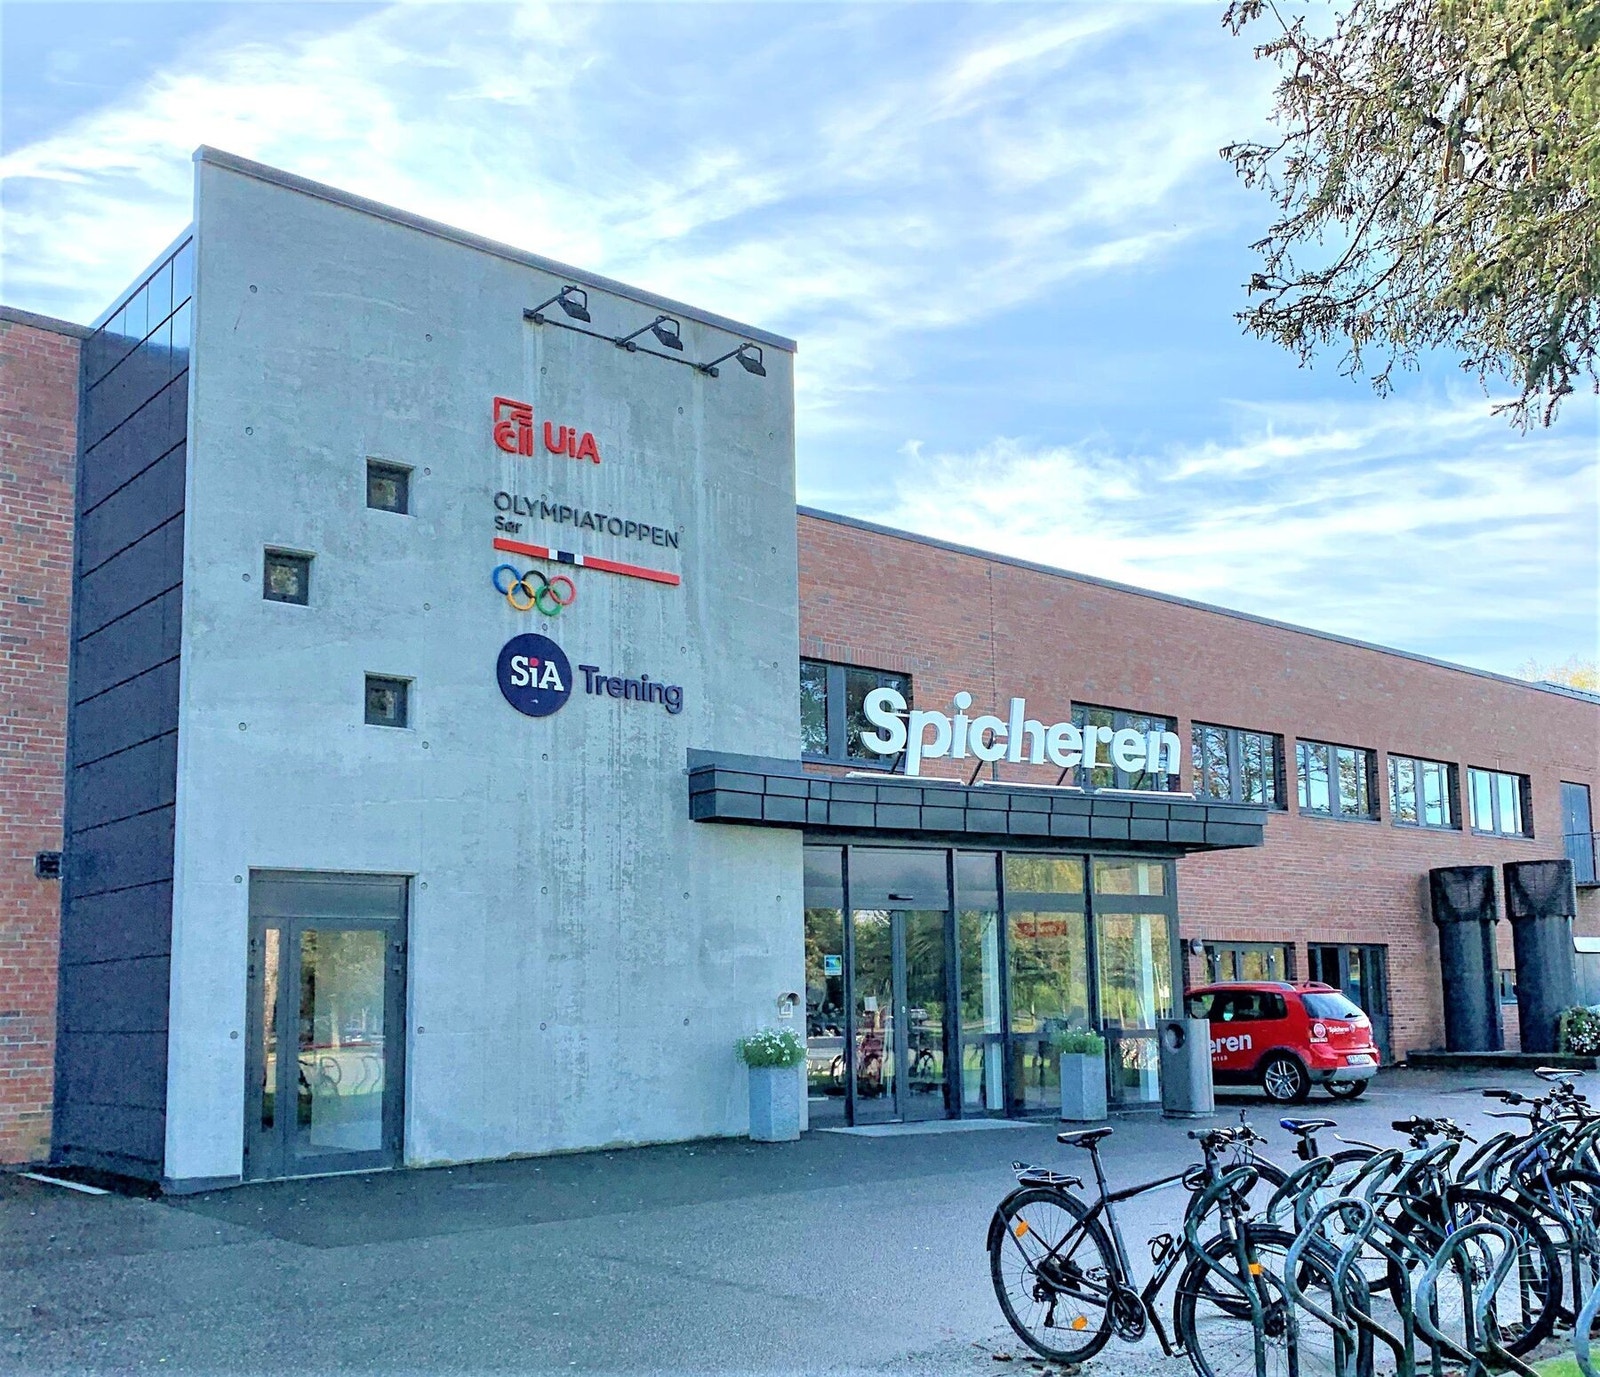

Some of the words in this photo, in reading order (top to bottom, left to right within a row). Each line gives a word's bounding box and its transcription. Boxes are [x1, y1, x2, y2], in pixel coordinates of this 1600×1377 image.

[543, 420, 601, 464] UiA
[493, 490, 680, 550] OLYMPIATOPPEN
[510, 655, 565, 692] SiA
[578, 663, 684, 715] Trening
[860, 687, 1182, 777] Spicheren
